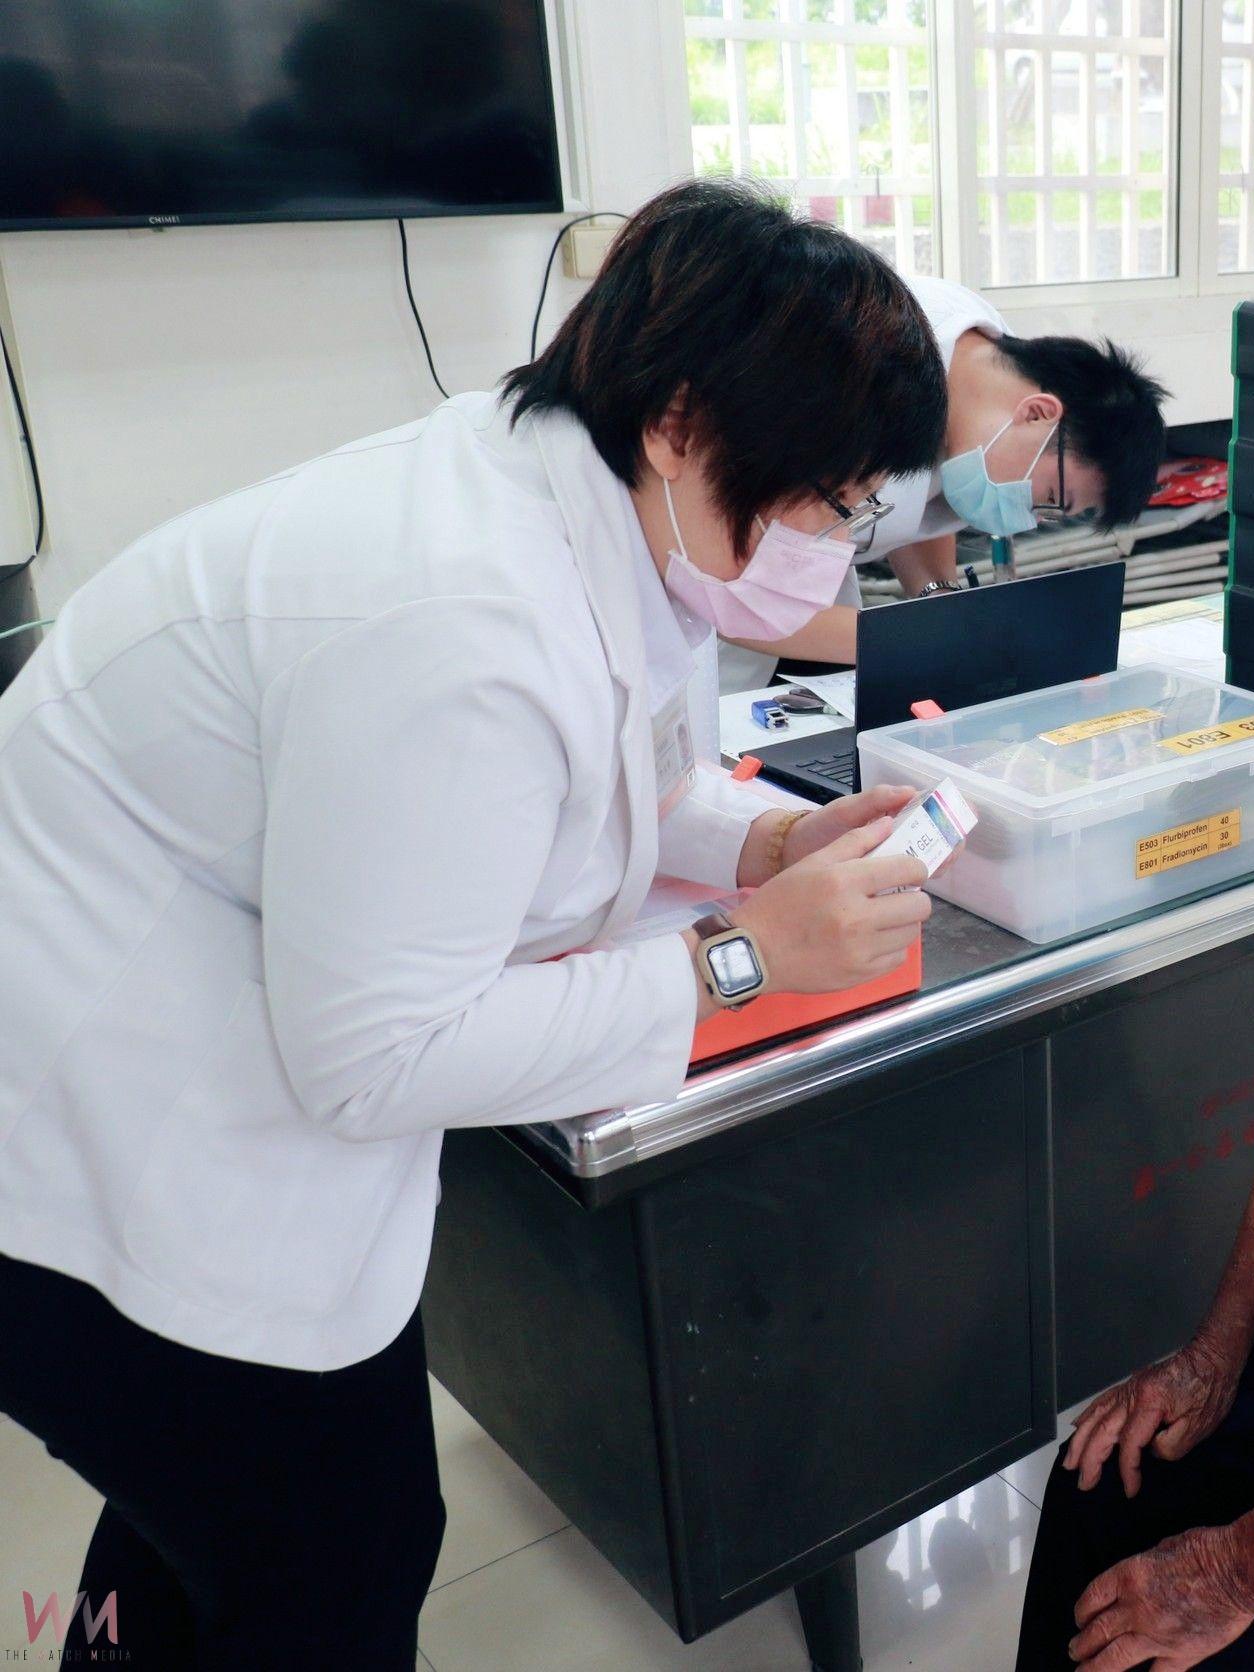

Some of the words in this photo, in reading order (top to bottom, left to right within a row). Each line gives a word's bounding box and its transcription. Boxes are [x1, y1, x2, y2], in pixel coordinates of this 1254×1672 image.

[148, 215, 182, 225] CHIMEI
[1177, 730, 1232, 749] E801
[917, 833, 933, 851] GEL
[1139, 839, 1159, 852] E503
[1162, 824, 1207, 844] Flurbiprofen
[1220, 816, 1229, 825] 40
[1139, 858, 1158, 871] E801
[1161, 843, 1207, 863] Fradiomycin
[1219, 831, 1229, 841] 30
